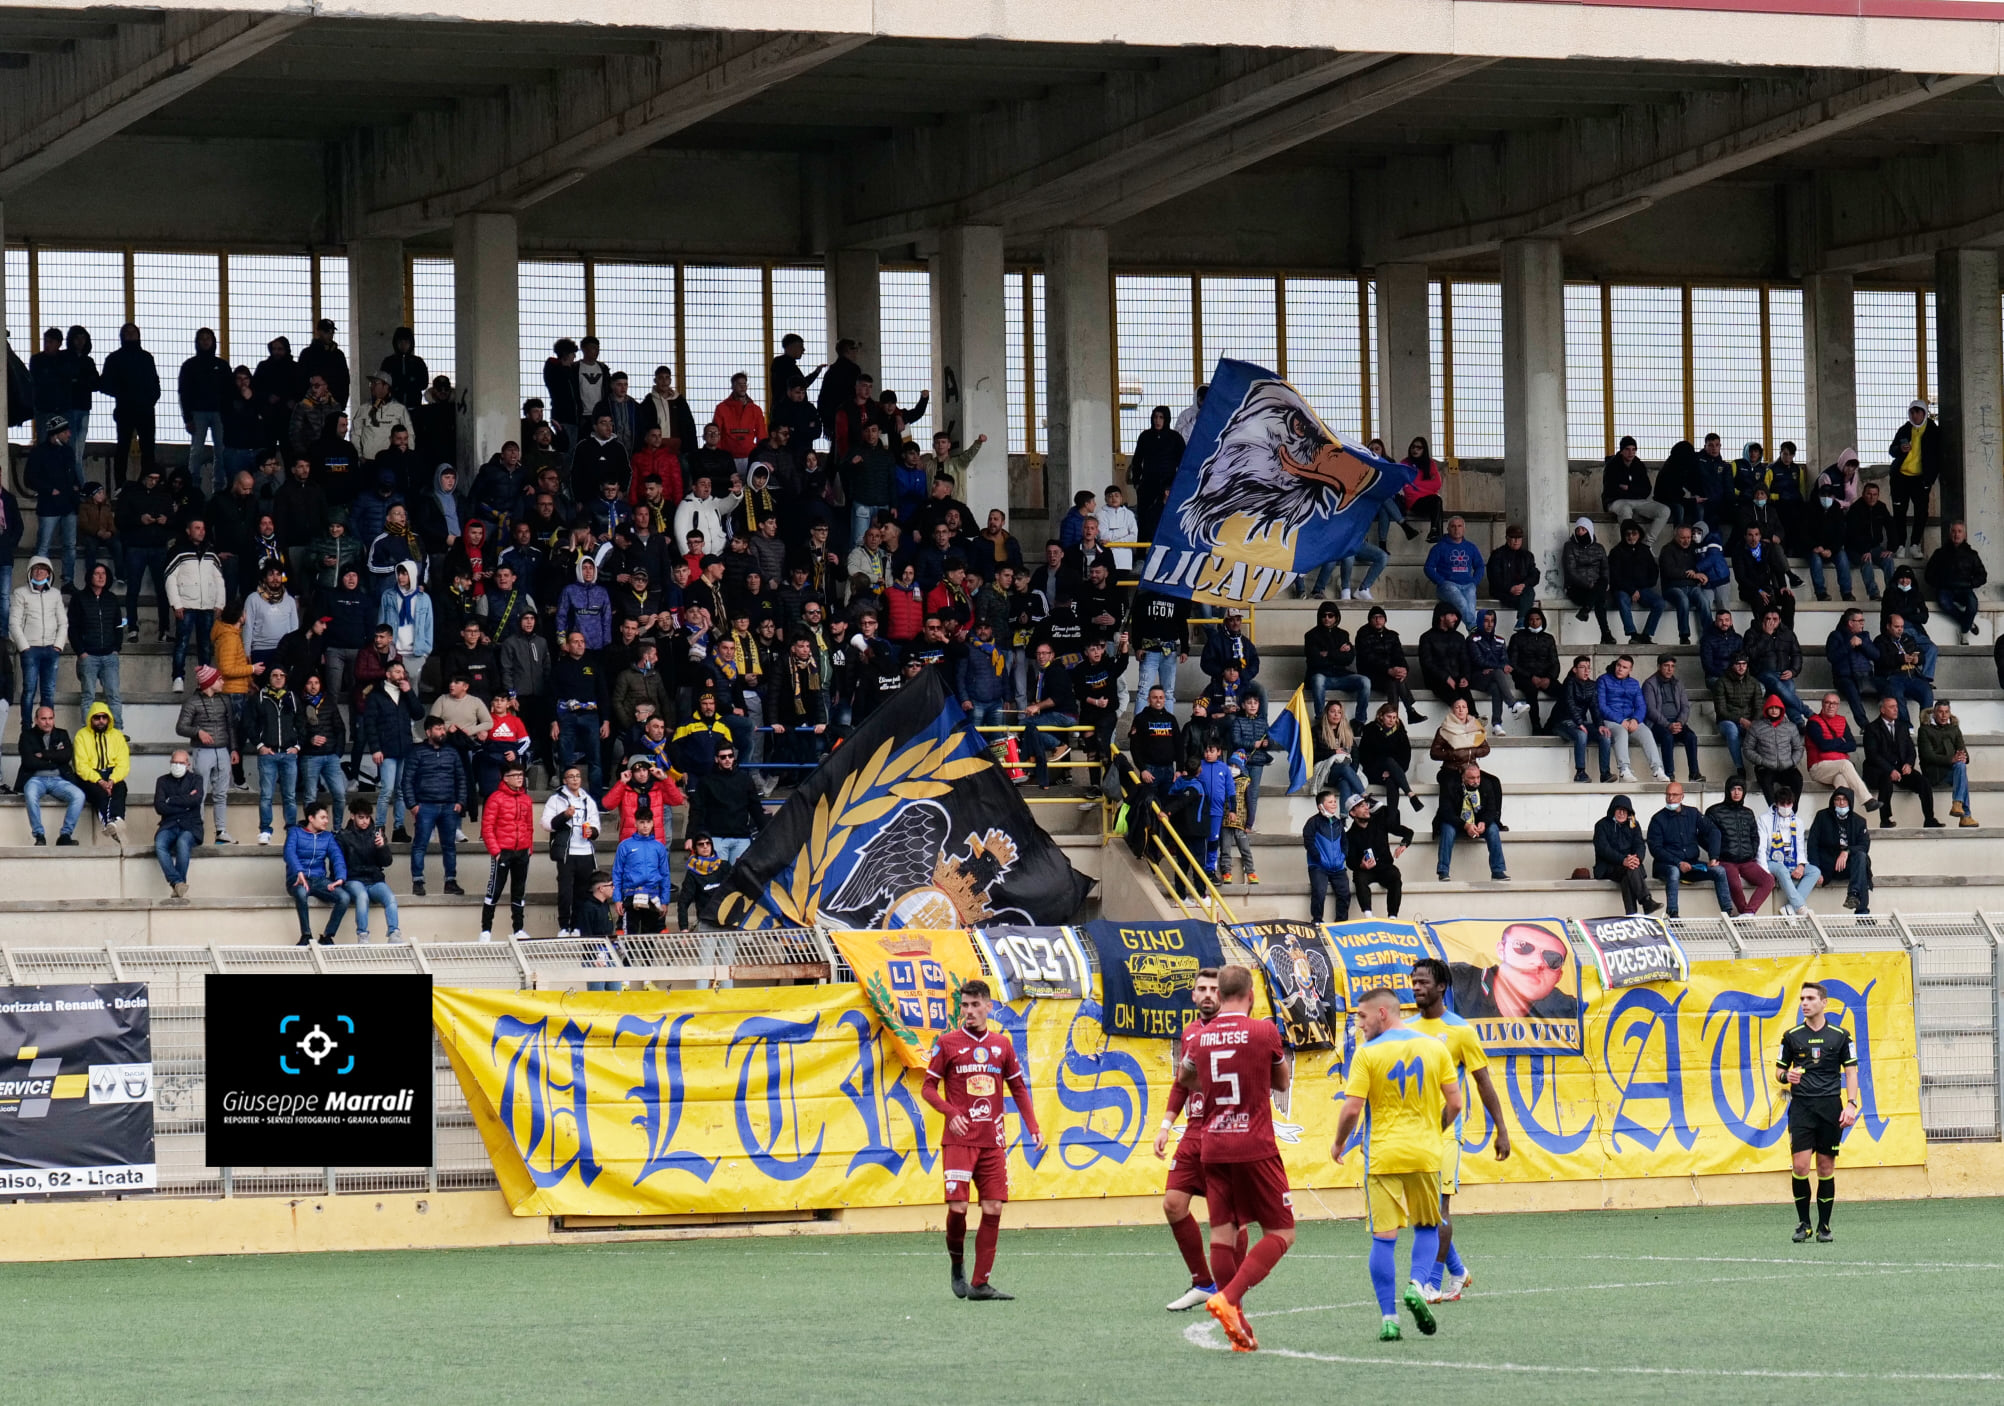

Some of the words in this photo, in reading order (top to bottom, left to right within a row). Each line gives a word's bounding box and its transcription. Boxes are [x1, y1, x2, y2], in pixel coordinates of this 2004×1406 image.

[1148, 605, 1174, 618] ICON
[1120, 928, 1184, 951] GINO
[1230, 924, 1287, 939] CURVA
[1287, 923, 1317, 939] SUD
[1335, 931, 1420, 949] VINCENZO
[1596, 917, 1663, 943] ASSENTI
[995, 935, 1078, 982] 1931
[1354, 949, 1419, 967] SEMPRE
[1604, 944, 1680, 977] PRESENTI
[1351, 973, 1414, 993] PRESEN
[55, 998, 105, 1012] Renault
[114, 996, 148, 1009] Dacia
[1114, 1004, 1135, 1030] ON
[1141, 1008, 1177, 1035] THE
[1200, 1030, 1250, 1047] MALTESE
[1475, 1023, 1526, 1042] ALVO
[1530, 1024, 1578, 1043] VIVE
[1210, 1049, 1241, 1106] 5
[1387, 1055, 1424, 1101] 11
[48, 1172, 72, 1187] 62
[88, 1169, 144, 1186] Licata
